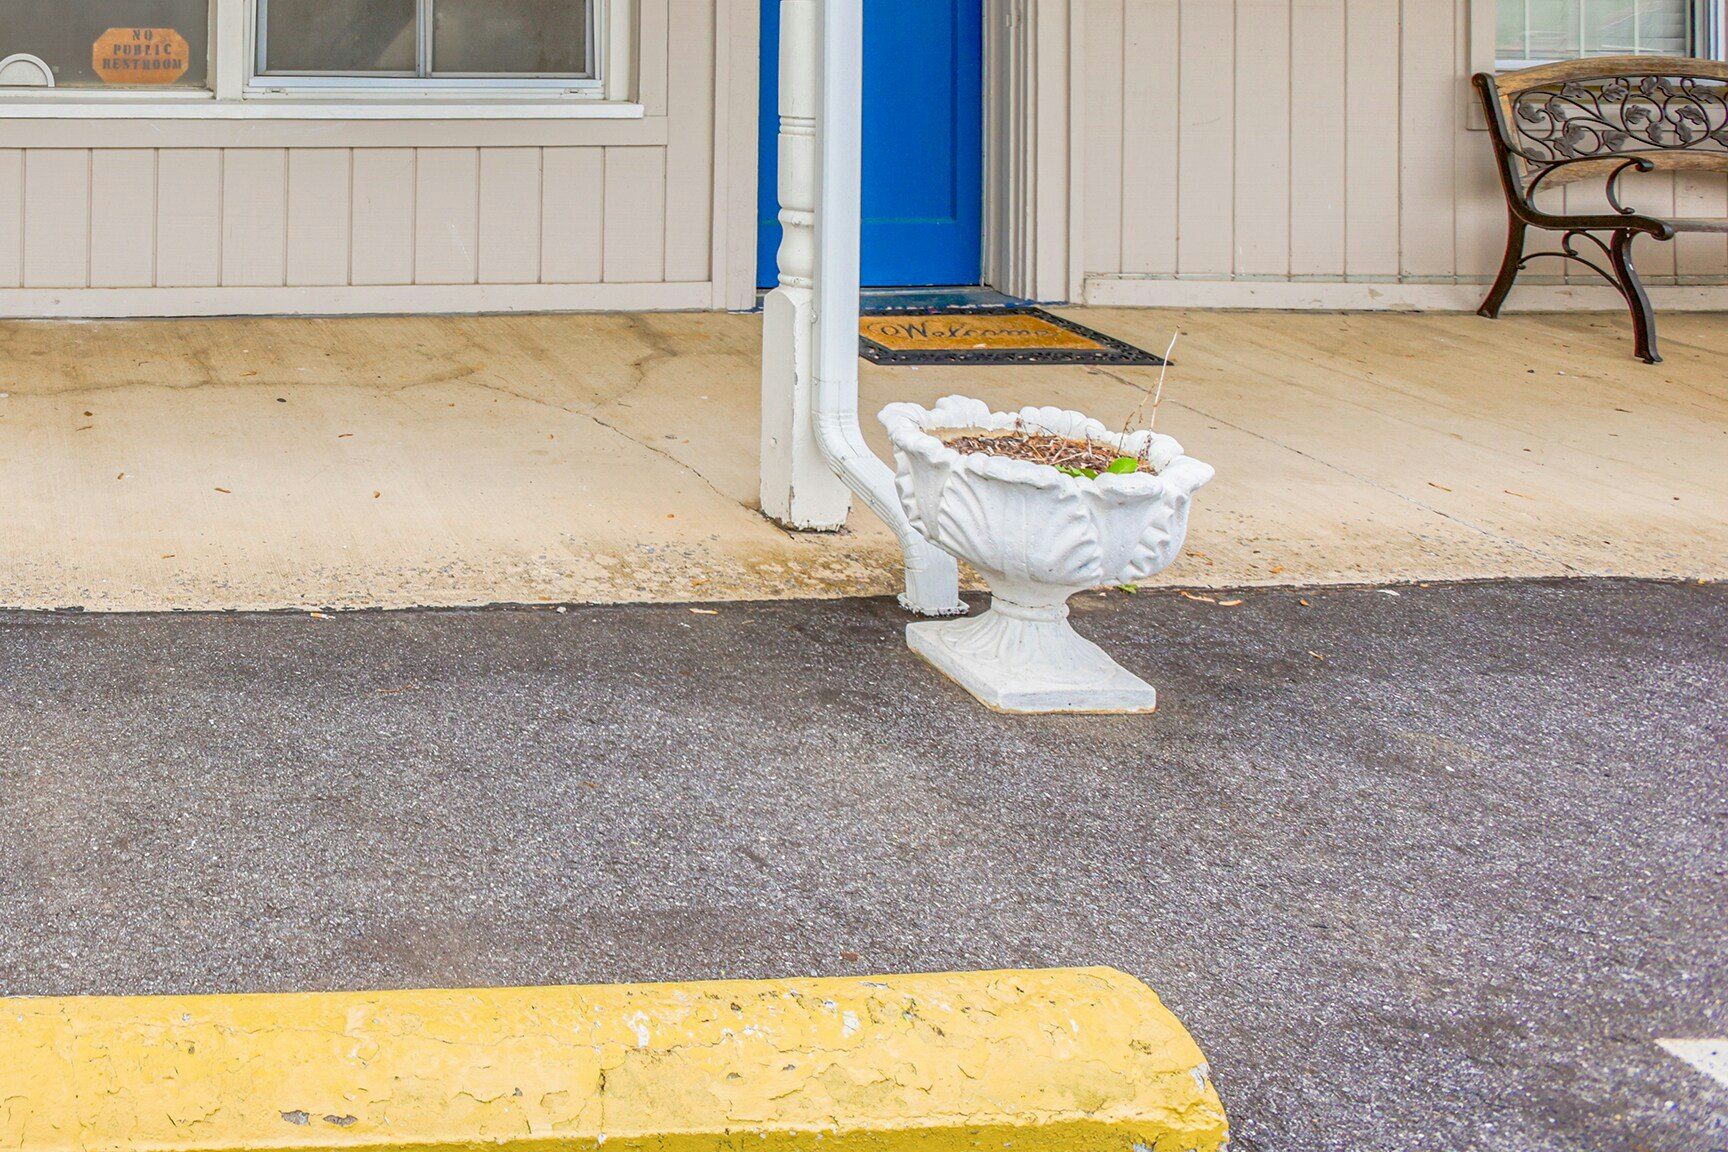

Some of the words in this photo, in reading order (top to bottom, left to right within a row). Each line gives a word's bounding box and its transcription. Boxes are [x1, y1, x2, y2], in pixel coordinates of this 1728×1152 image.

[132, 29, 154, 41] NO
[113, 42, 172, 56] PUBLIC
[103, 57, 182, 70] RESTROOM
[866, 320, 1059, 340] Welcome
